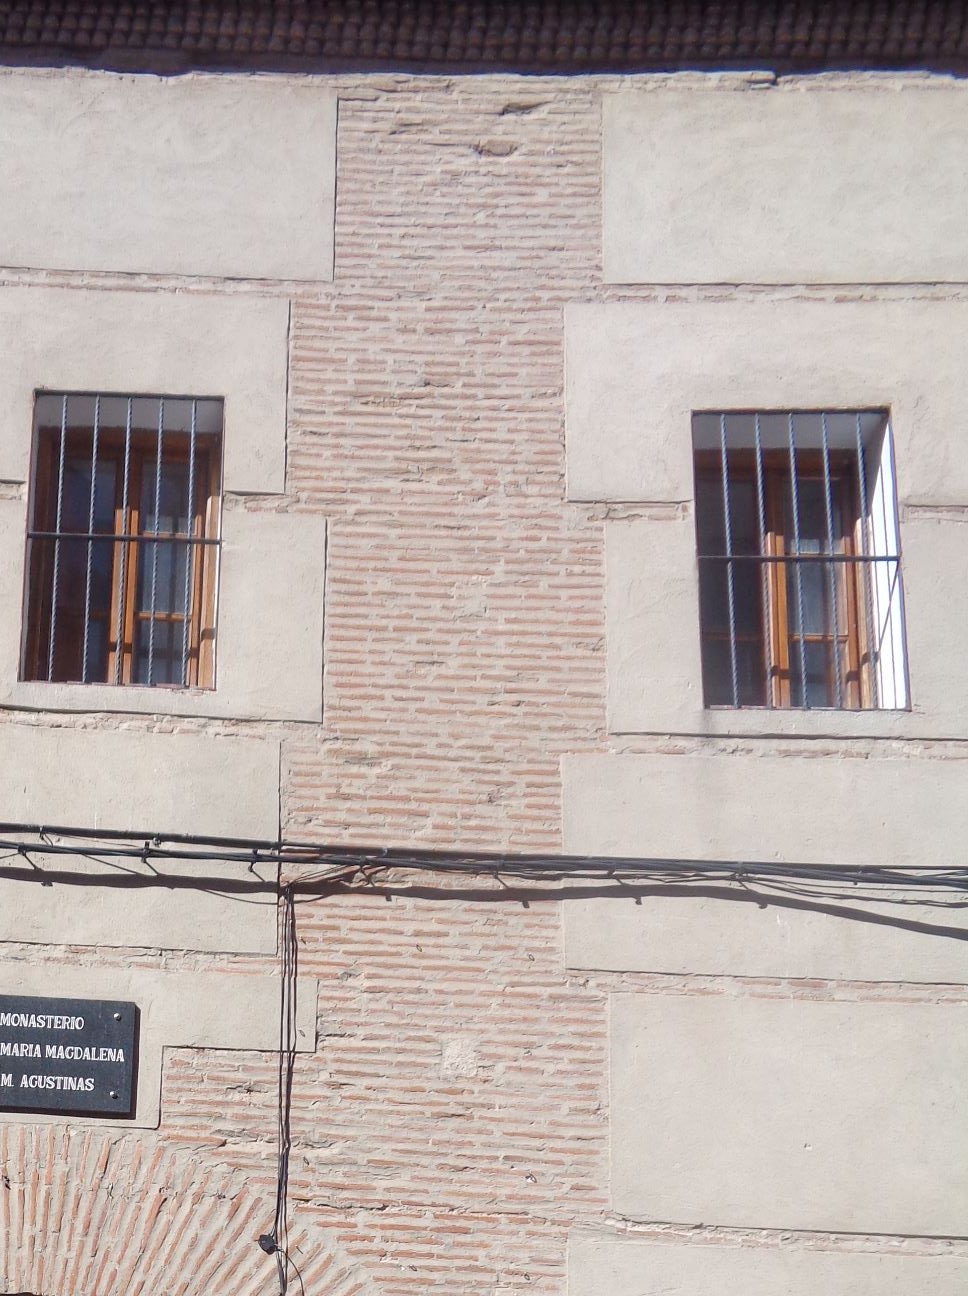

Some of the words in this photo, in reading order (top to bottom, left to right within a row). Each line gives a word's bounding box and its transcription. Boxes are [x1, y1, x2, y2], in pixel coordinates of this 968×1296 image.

[0, 1012, 85, 1030] MONASTERIO
[0, 1042, 42, 1058] MARIA
[45, 1044, 125, 1062] MAGDALENA
[20, 1074, 95, 1091] AGUSTINAS
